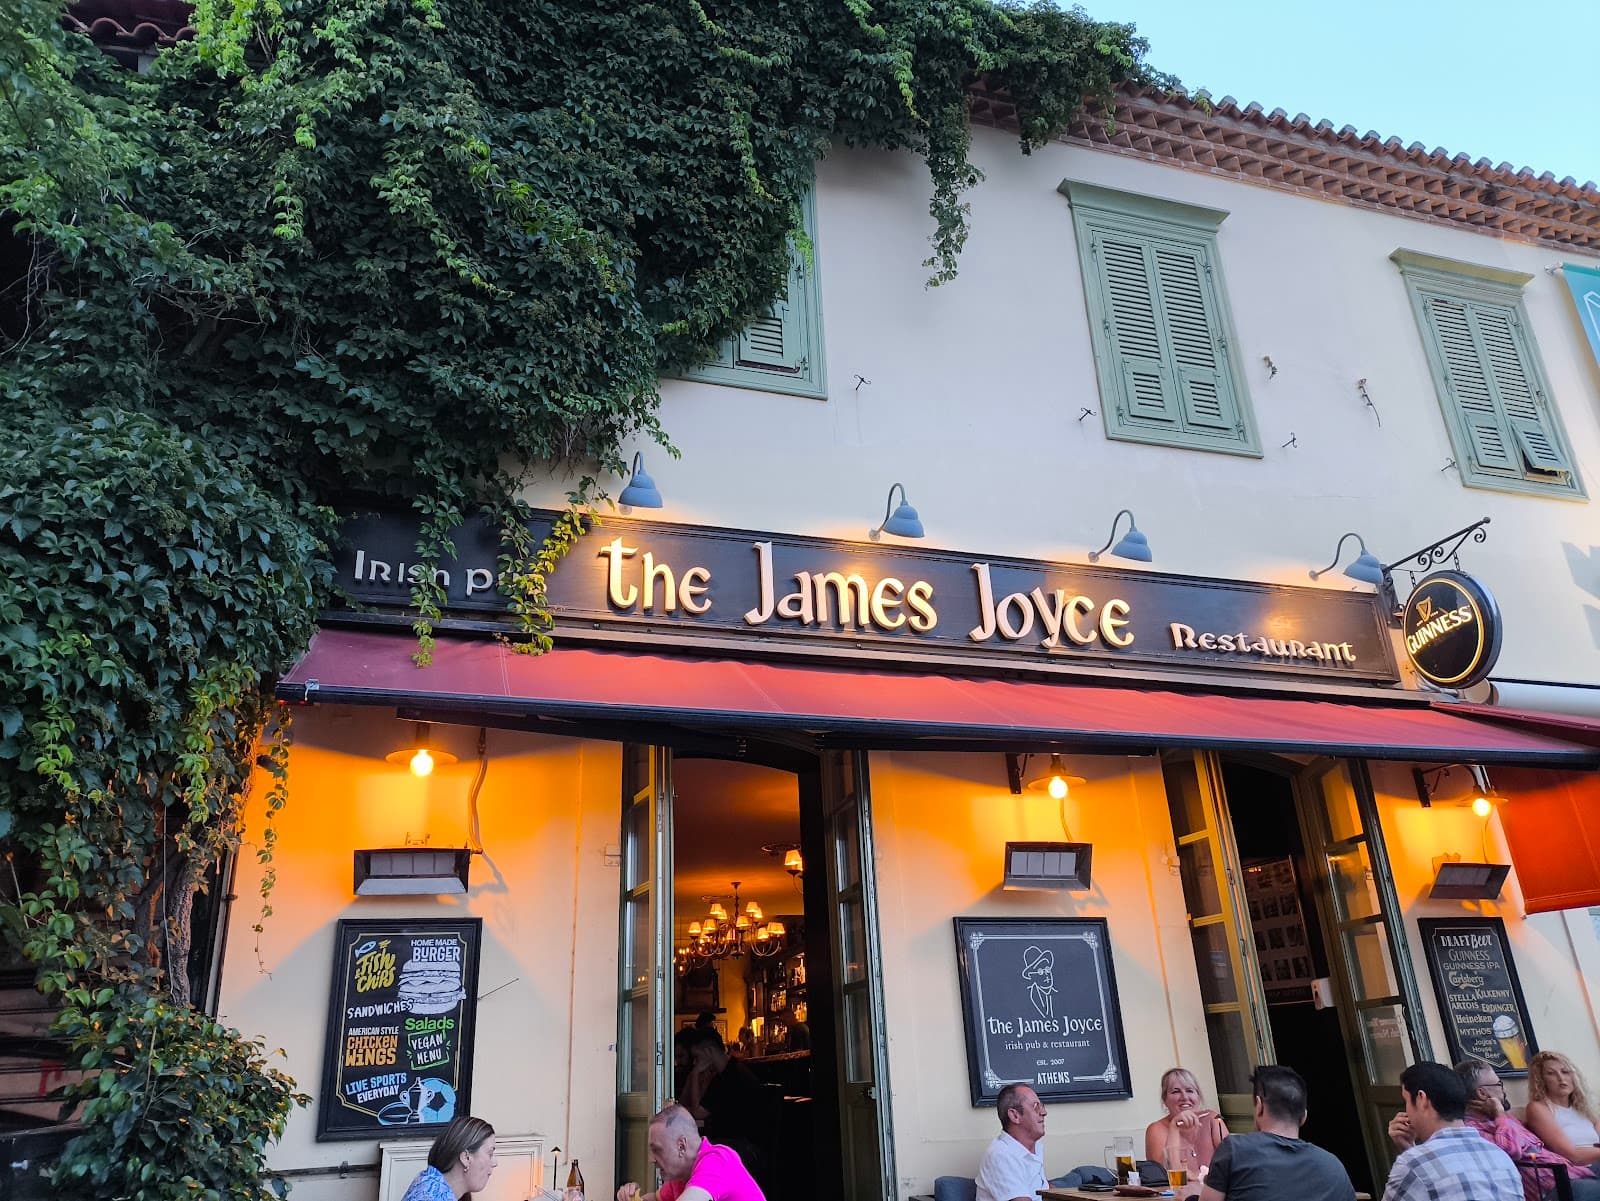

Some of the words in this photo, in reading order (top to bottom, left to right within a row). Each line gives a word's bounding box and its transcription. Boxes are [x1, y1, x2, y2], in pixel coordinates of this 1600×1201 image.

[600, 536, 713, 615] the
[743, 541, 938, 632] James
[968, 562, 1135, 649] Joyce
[1407, 604, 1473, 655] GUINNESS
[1170, 622, 1357, 662] Restaurant
[411, 939, 435, 947] HOME
[412, 946, 461, 962] BURGER
[1448, 949, 1491, 962] GUINNESS
[1443, 961, 1486, 970] GUINNESS
[1486, 961, 1501, 970] IPA
[1448, 970, 1485, 989] Carlsberg
[1449, 993, 1477, 1002] STELLA
[347, 1000, 413, 1019] SANDWICHES
[1451, 1001, 1480, 1010] ARTOIS
[404, 1016, 455, 1031] Salads
[987, 1016, 1014, 1035] the
[1016, 1017, 1060, 1038] James
[1062, 1015, 1103, 1036] Joyce
[1455, 1014, 1493, 1024] Heineken
[348, 1027, 380, 1036] AMERICAN
[380, 1026, 400, 1035] STYLE
[1459, 1026, 1493, 1036] MYTHOS
[411, 1034, 443, 1051] VEGAN
[1005, 1040, 1024, 1051] irish
[1025, 1039, 1041, 1052] pub
[1042, 1041, 1049, 1049] &
[1050, 1040, 1091, 1048] restaurant
[416, 1048, 442, 1065] MENU
[345, 1078, 369, 1095] LIVE
[370, 1072, 408, 1090] SPORTS
[1037, 1071, 1070, 1085] ATHENS
[357, 1084, 401, 1104] EVERYDAY
